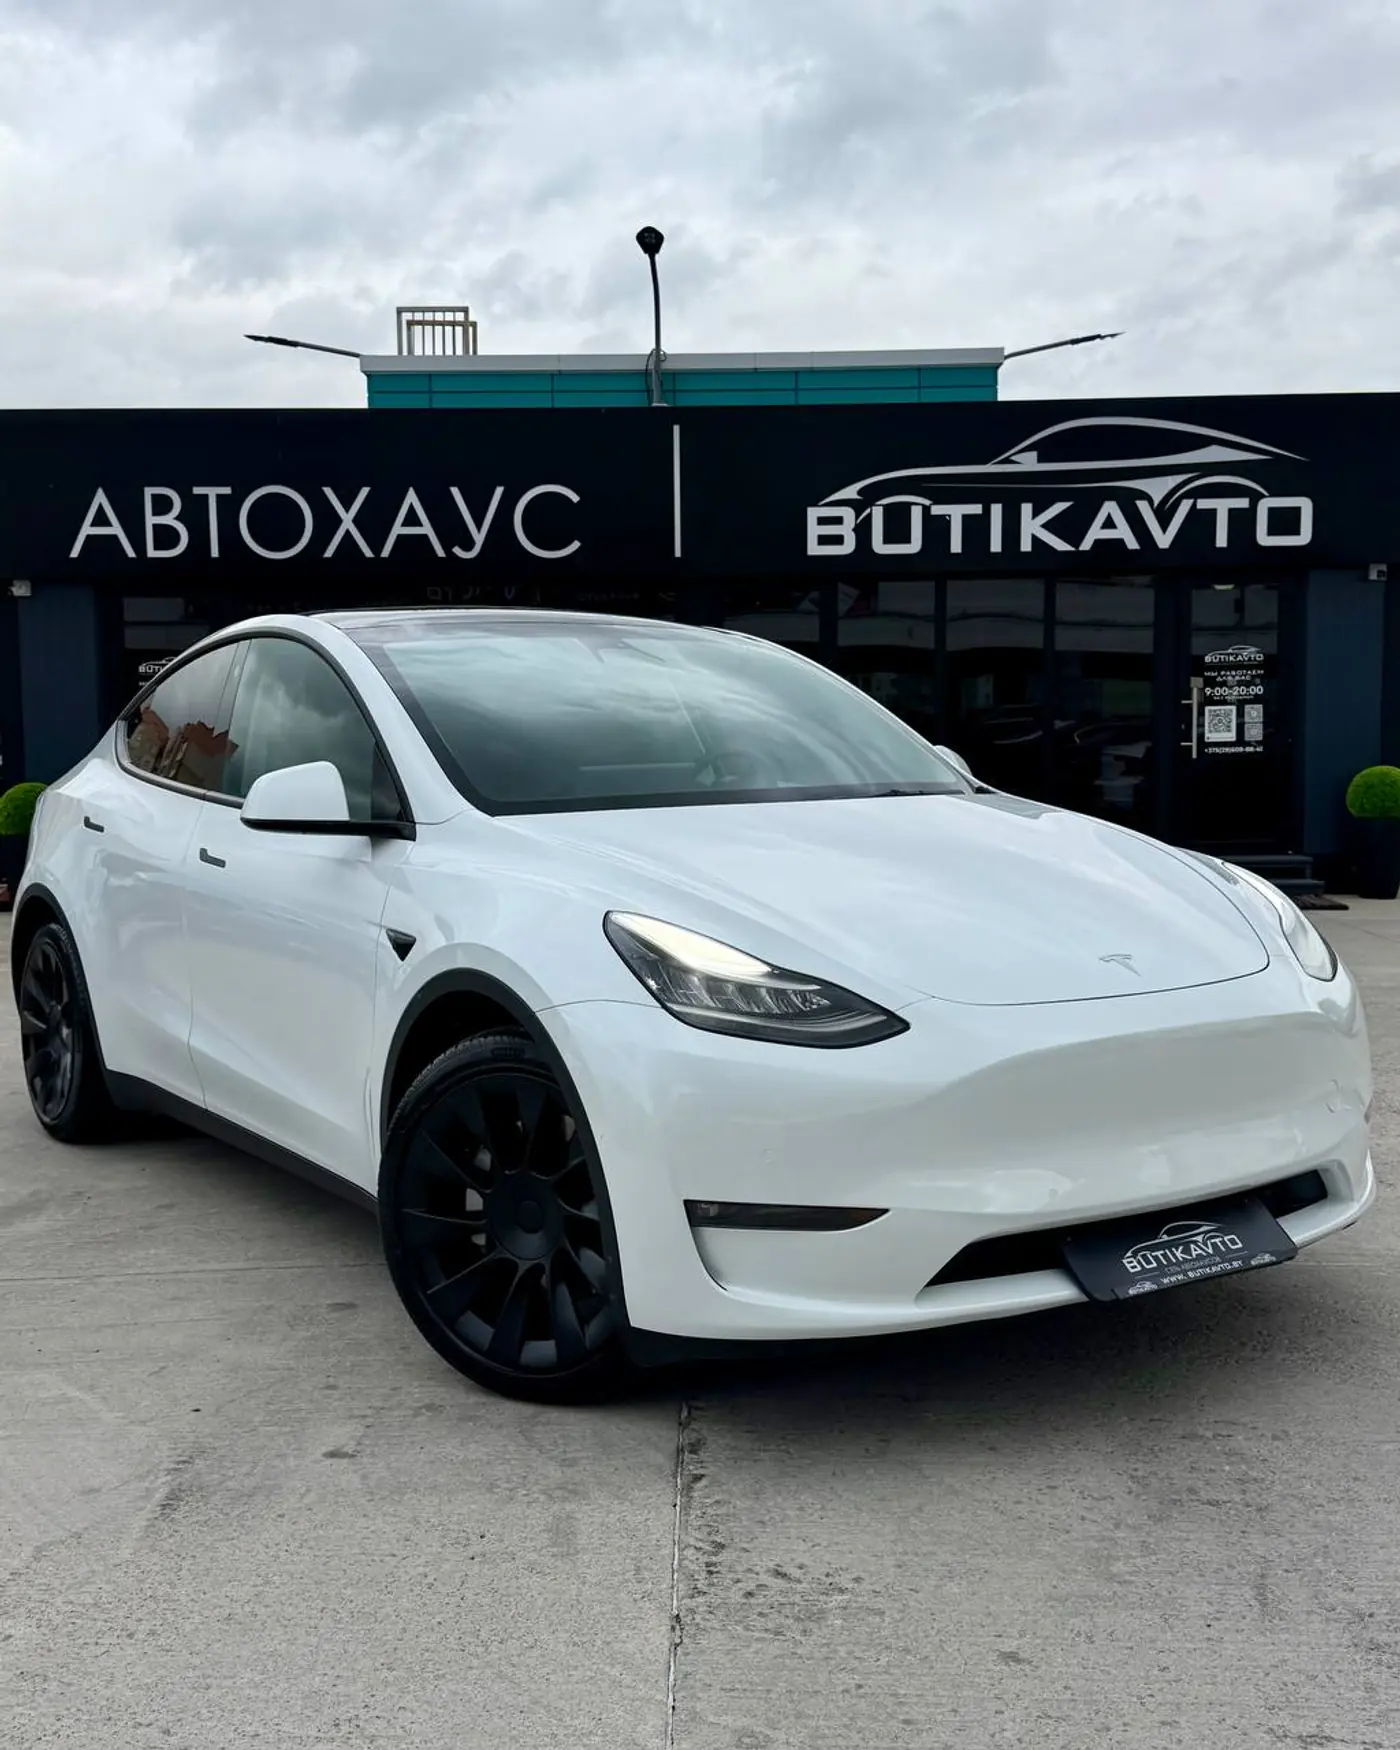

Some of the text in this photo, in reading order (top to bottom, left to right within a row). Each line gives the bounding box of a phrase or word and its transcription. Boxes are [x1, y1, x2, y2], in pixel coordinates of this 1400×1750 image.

[69, 484, 581, 560] АВТОХАУС
[806, 496, 1313, 556] BUTIKAVTO
[1204, 654, 1264, 663] BUTIKAVTO
[1204, 685, 1264, 696] 9:00-20:00
[1122, 1234, 1243, 1273] BUTIKAVTO
